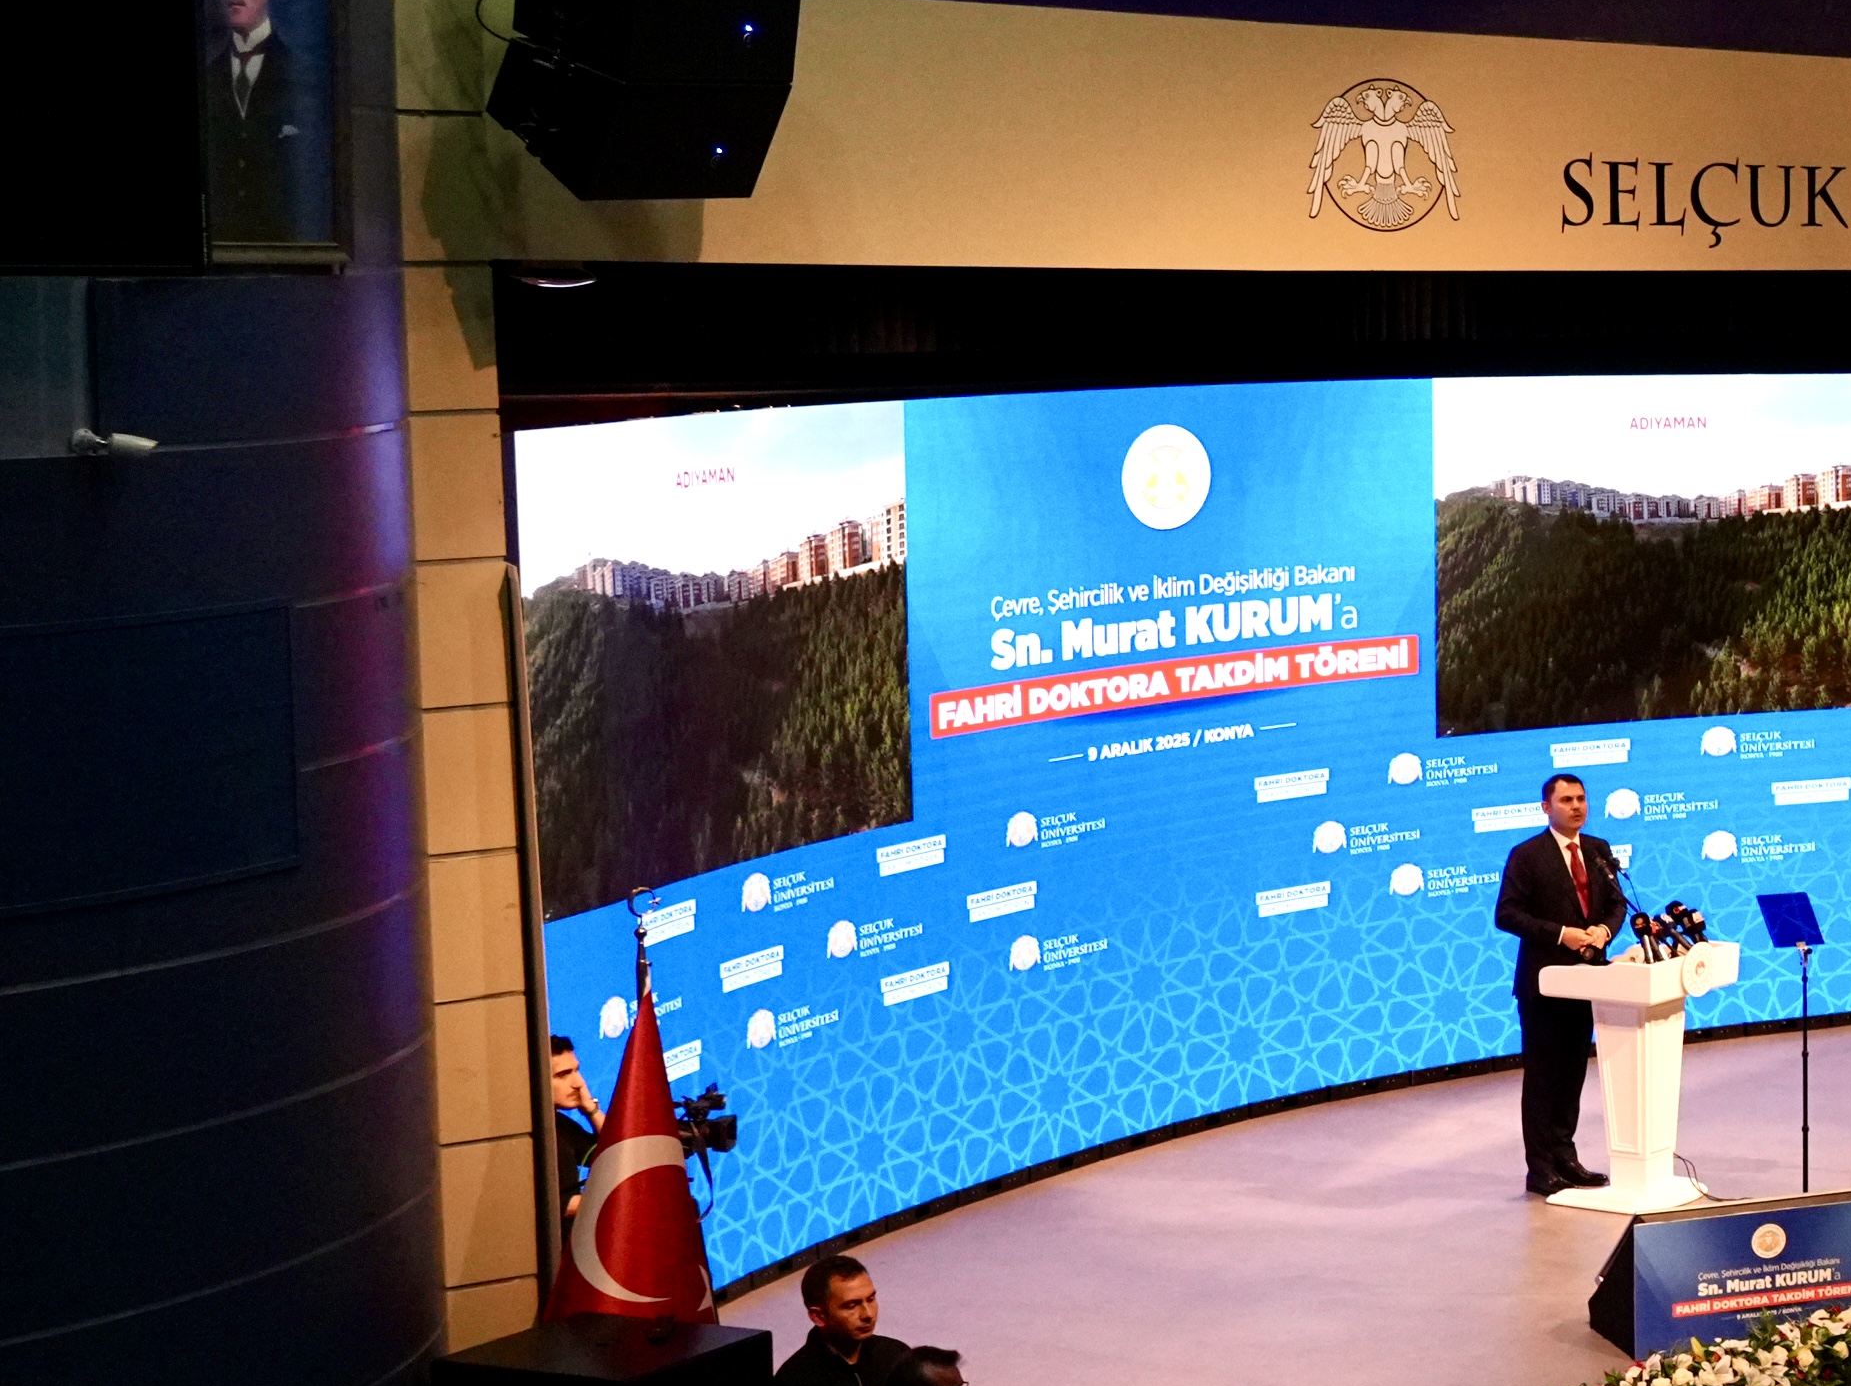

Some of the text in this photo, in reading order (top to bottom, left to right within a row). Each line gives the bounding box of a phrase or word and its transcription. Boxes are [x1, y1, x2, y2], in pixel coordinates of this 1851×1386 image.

[1561, 151, 1849, 249] SELÇUK
[1629, 416, 1707, 430] ADIYAMAN
[675, 467, 735, 489] ADIYAMAN
[991, 563, 1356, 622] Çevre, Şehircilik ve İklim Değişikliği Bakanı
[990, 627, 1054, 671] Sn.
[1061, 609, 1176, 662] Murat
[939, 639, 1409, 730] FAHRİ DOKTORA TAKDİM TÖRENİ
[1087, 746, 1098, 762] 9
[1100, 738, 1154, 760] ARALIK
[1155, 732, 1191, 752] 2025
[1204, 723, 1255, 745] KONYA
[1503, 805, 1543, 816] DOKTOR
[1676, 1300, 1711, 1315] FAHRİ
[1712, 1295, 1770, 1310] DOKTORA
[1772, 1288, 1816, 1303] TAKDİM
[1697, 1282, 1724, 1297] Sn.
[1726, 1275, 1773, 1293] Murat
